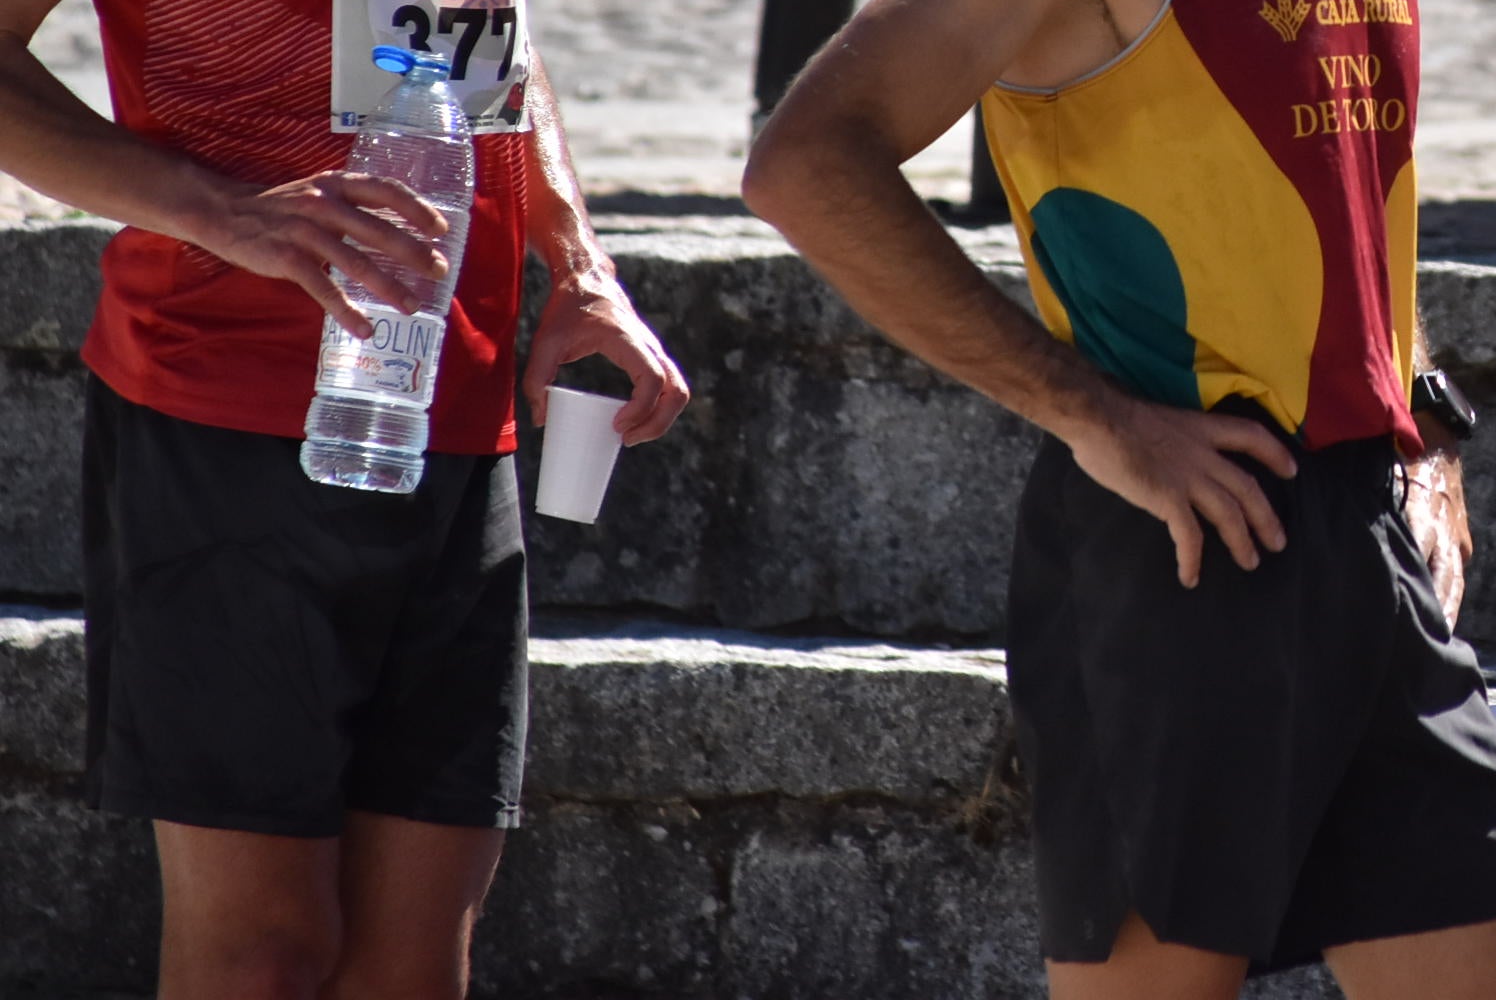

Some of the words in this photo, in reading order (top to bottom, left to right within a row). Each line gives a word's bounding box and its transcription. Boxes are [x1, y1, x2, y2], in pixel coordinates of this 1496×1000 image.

[392, 4, 517, 81] 377
[1318, 53, 1381, 89] VINO
[1291, 101, 1341, 138] DE
[1341, 98, 1406, 133] TORO
[324, 314, 431, 358] AOLÍN
